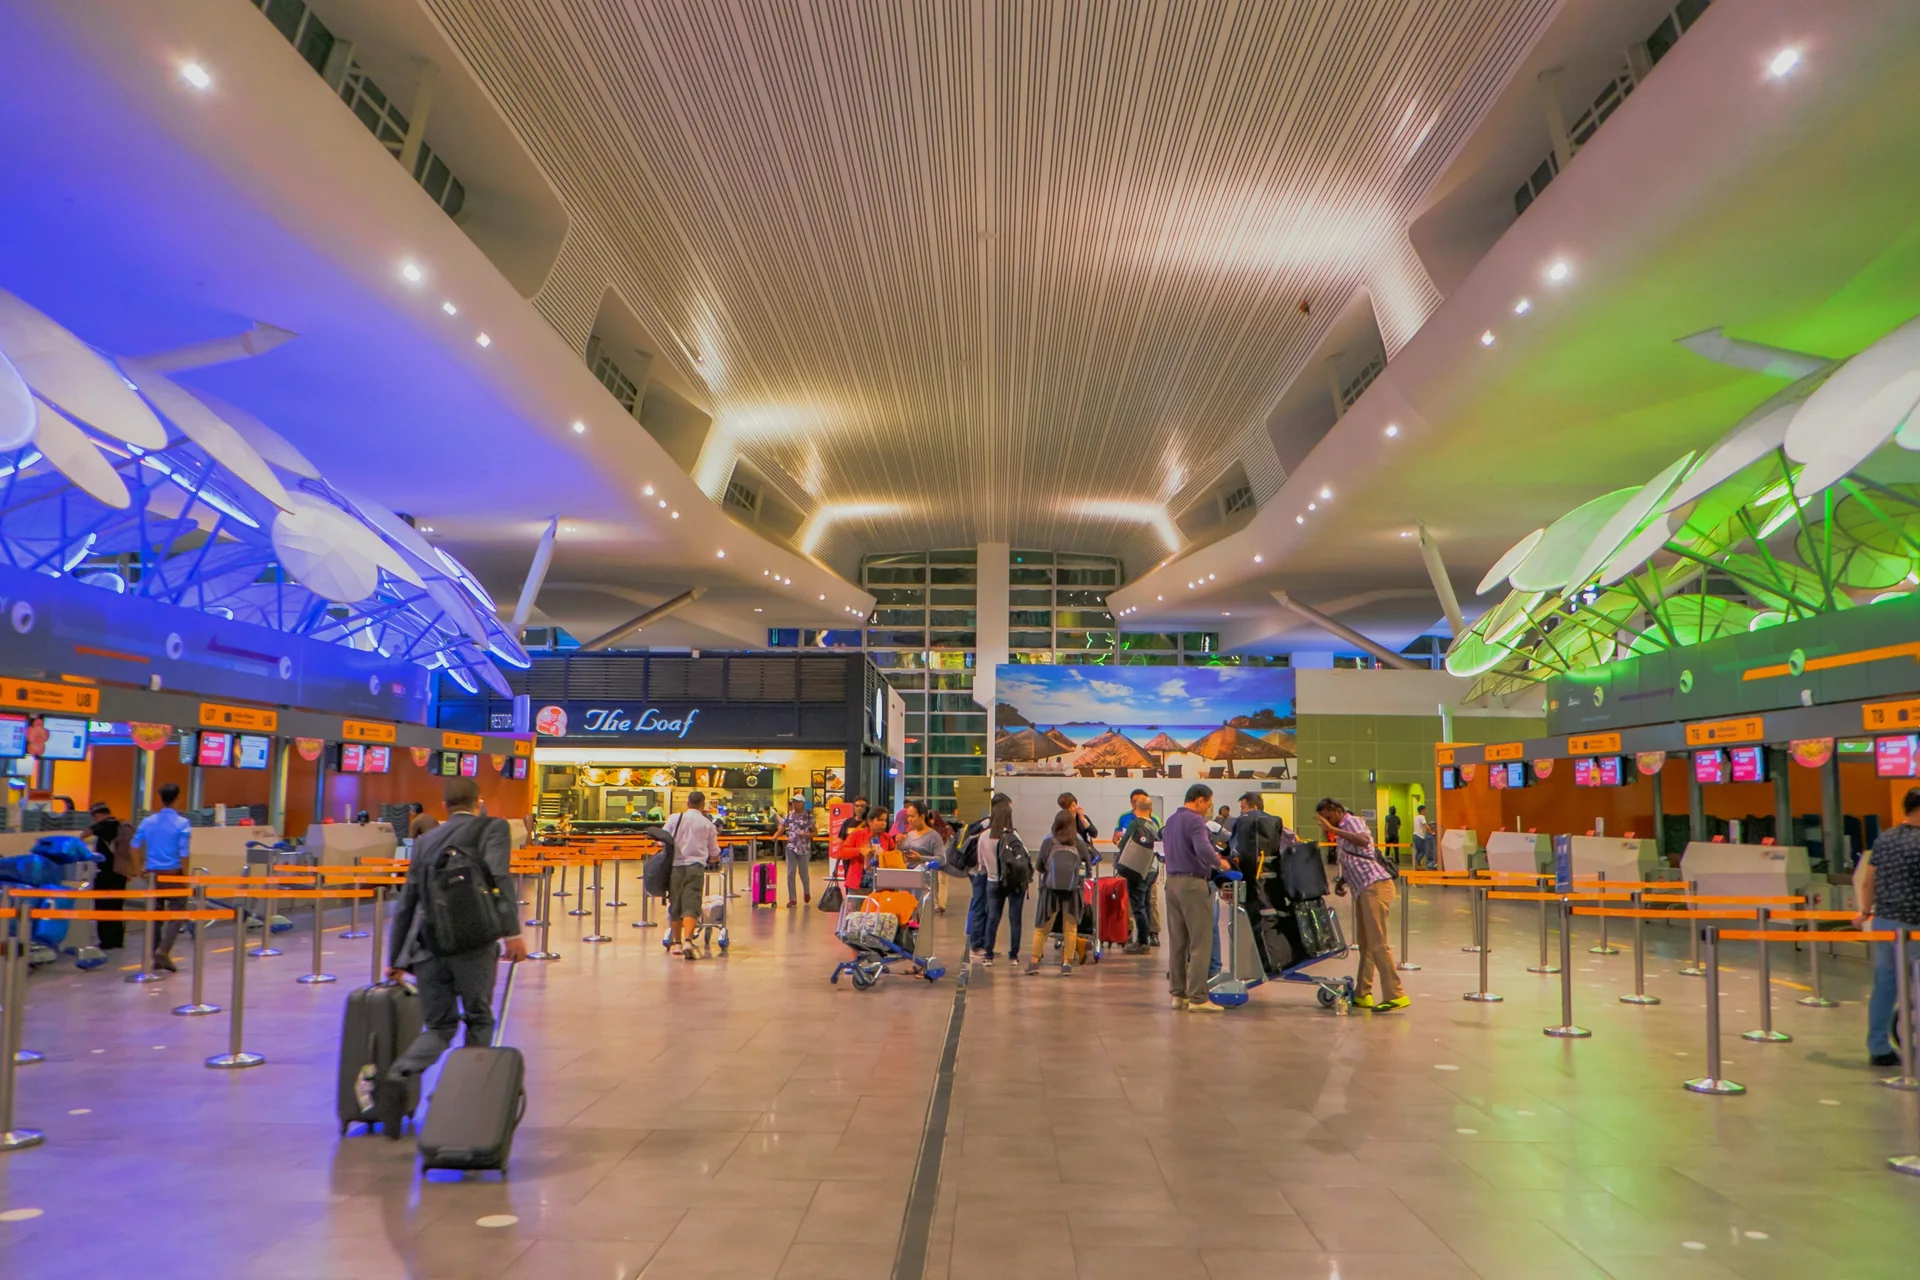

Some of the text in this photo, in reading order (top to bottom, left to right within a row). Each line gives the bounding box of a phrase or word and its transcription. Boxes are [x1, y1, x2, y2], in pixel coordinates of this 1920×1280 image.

[76, 693, 92, 707] U8
[584, 708, 700, 738] The Loaf
